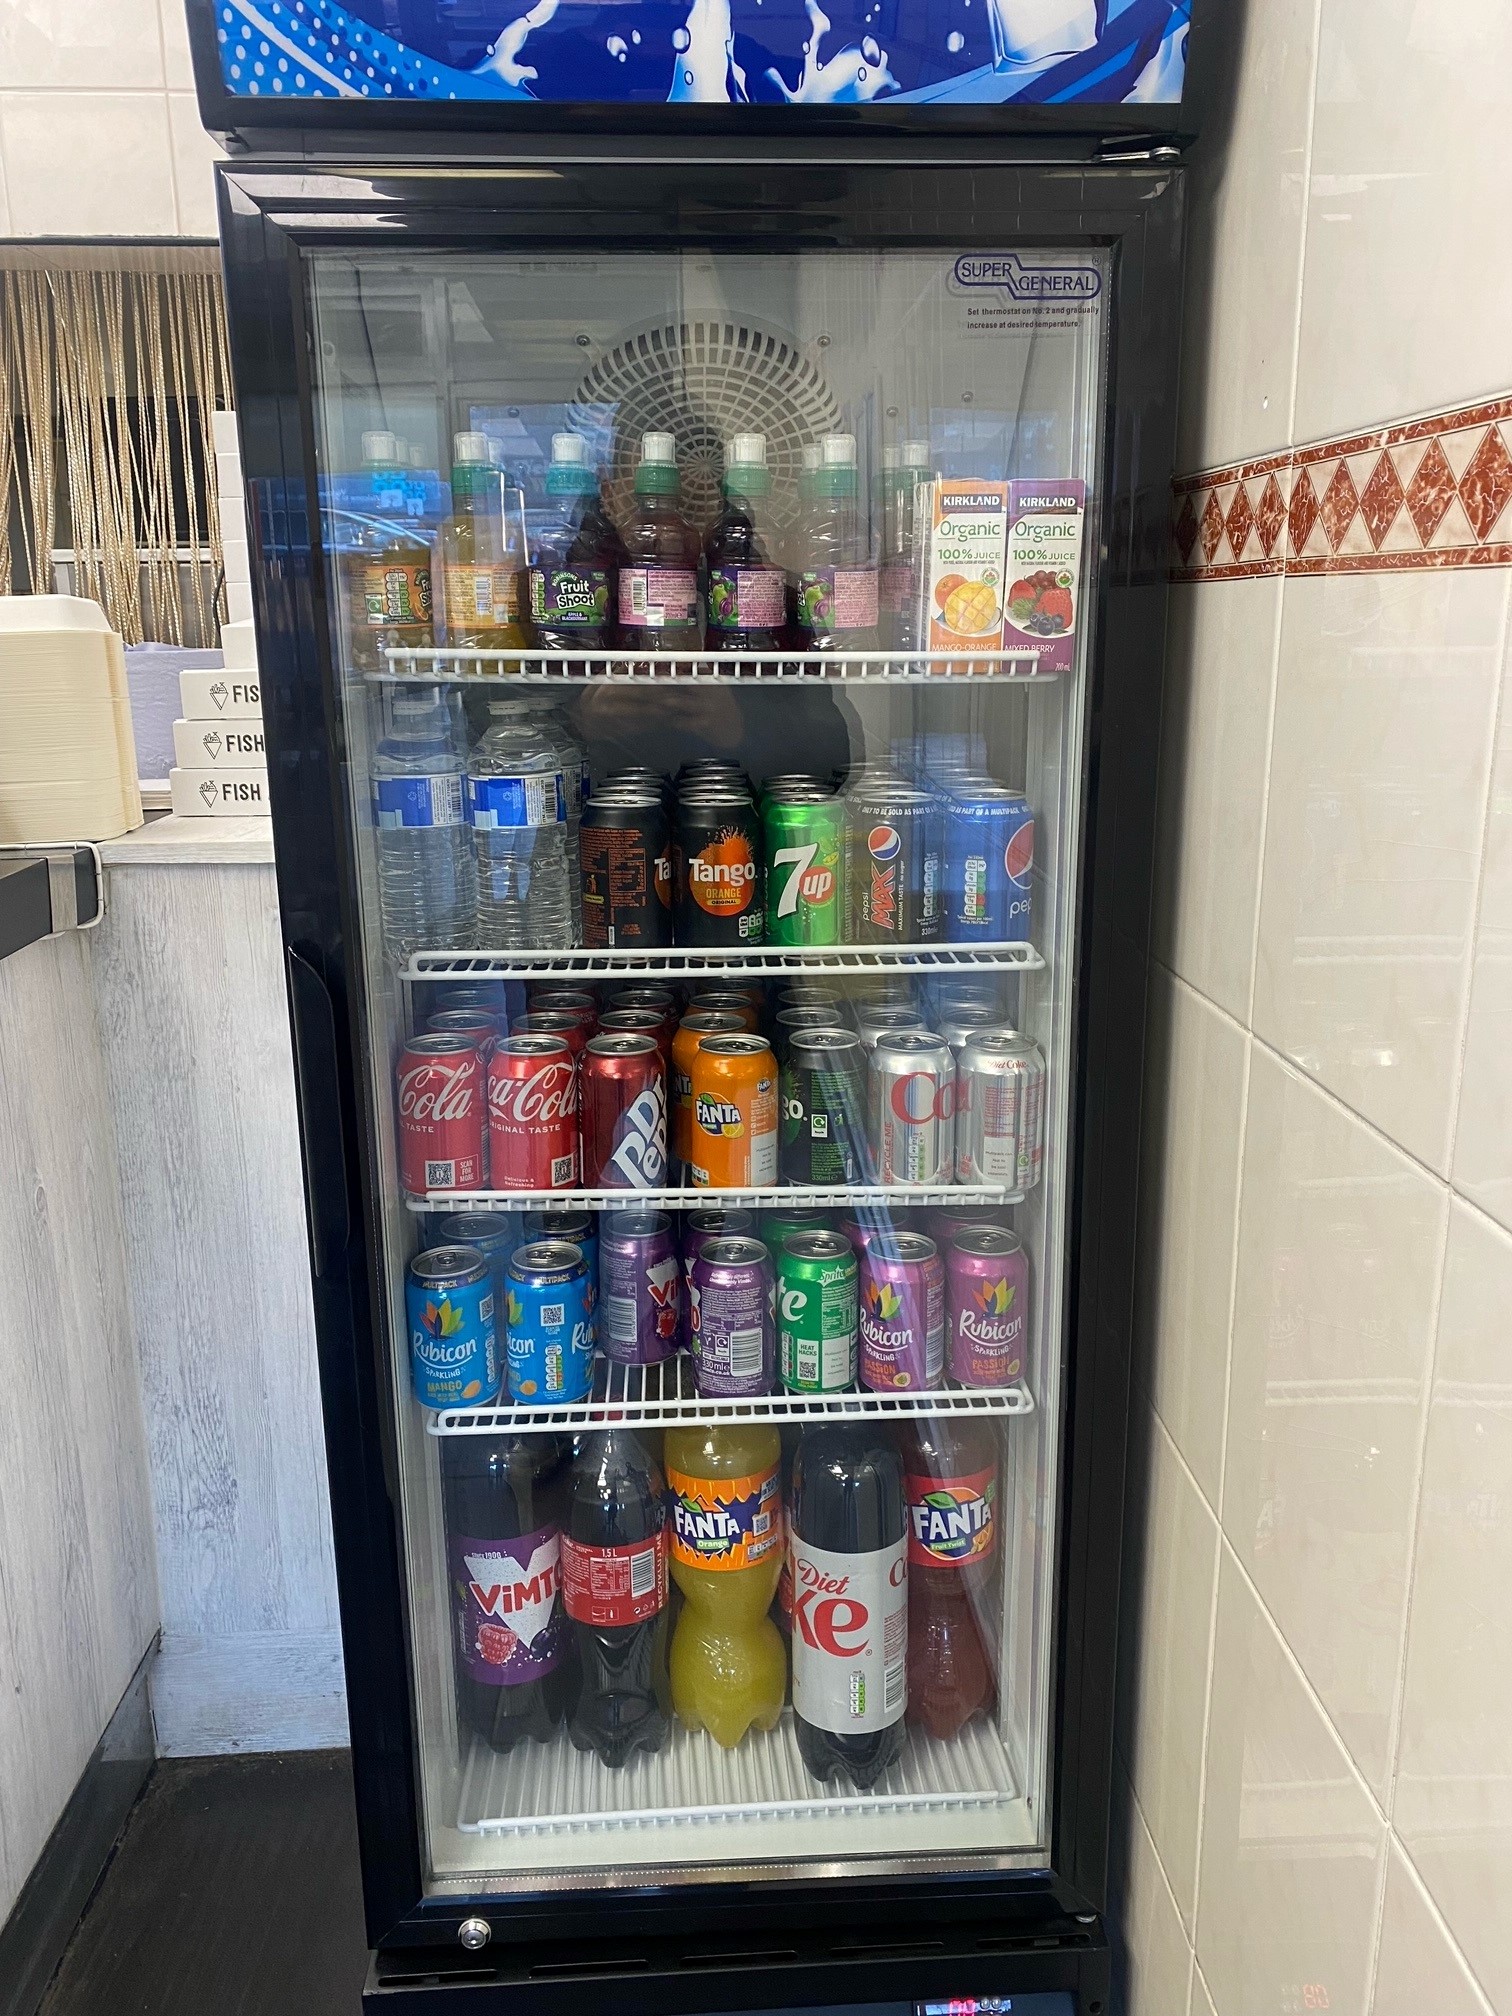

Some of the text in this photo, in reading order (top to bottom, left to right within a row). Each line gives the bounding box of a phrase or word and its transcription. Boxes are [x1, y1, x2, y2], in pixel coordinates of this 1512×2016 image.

[961, 262, 1014, 280] SUPER
[1018, 275, 1095, 291] GENERAL
[967, 307, 979, 315] Set
[981, 307, 1021, 315] thermostat
[1032, 307, 1044, 315] No.
[1051, 306, 1065, 314] and
[1066, 306, 1099, 317] gradually
[967, 321, 998, 329] increase
[999, 321, 1006, 329] at
[943, 496, 1000, 506] KIRKLAND
[1019, 497, 1076, 507] KIRKLAND
[940, 520, 1000, 542] Organic
[1014, 521, 1076, 543] Organic
[938, 549, 973, 560] 100%
[1013, 549, 1076, 560] 100% JUICE
[560, 580, 589, 594] Fruit
[557, 594, 594, 608] Shoot
[931, 643, 997, 651] MANGO-ORANGE
[1031, 644, 1055, 653] BERRY
[232, 684, 260, 703] FIS
[225, 734, 265, 752] FISH
[222, 783, 261, 801] FISH
[873, 807, 880, 815] TO
[888, 808, 903, 816] SOLD
[904, 808, 912, 816] AS
[912, 807, 925, 815] PART
[962, 807, 975, 815] PART
[984, 808, 990, 816] A
[705, 887, 741, 899] ORANGE
[871, 861, 896, 930] MAX
[400, 1059, 476, 1121] Cola
[695, 1099, 742, 1123] FANTA
[406, 1122, 435, 1133] TASTE
[528, 1123, 561, 1134] TASTE
[884, 1121, 892, 1184] RECYCLE ME
[460, 1159, 473, 1168] SCAN
[462, 1167, 472, 1175] FOR
[459, 1173, 474, 1183] MORE
[820, 1268, 844, 1283] Sprite
[959, 1308, 1022, 1340] Rubicon
[413, 1330, 478, 1362] Rubicon
[427, 1380, 463, 1392] MANGO
[674, 1503, 741, 1539] FANTA
[911, 1497, 992, 1540] FANTA
[697, 1539, 729, 1549] Orange
[931, 1542, 947, 1550] Fruit
[612, 1548, 618, 1557] L
[797, 1558, 851, 1595] Diet
